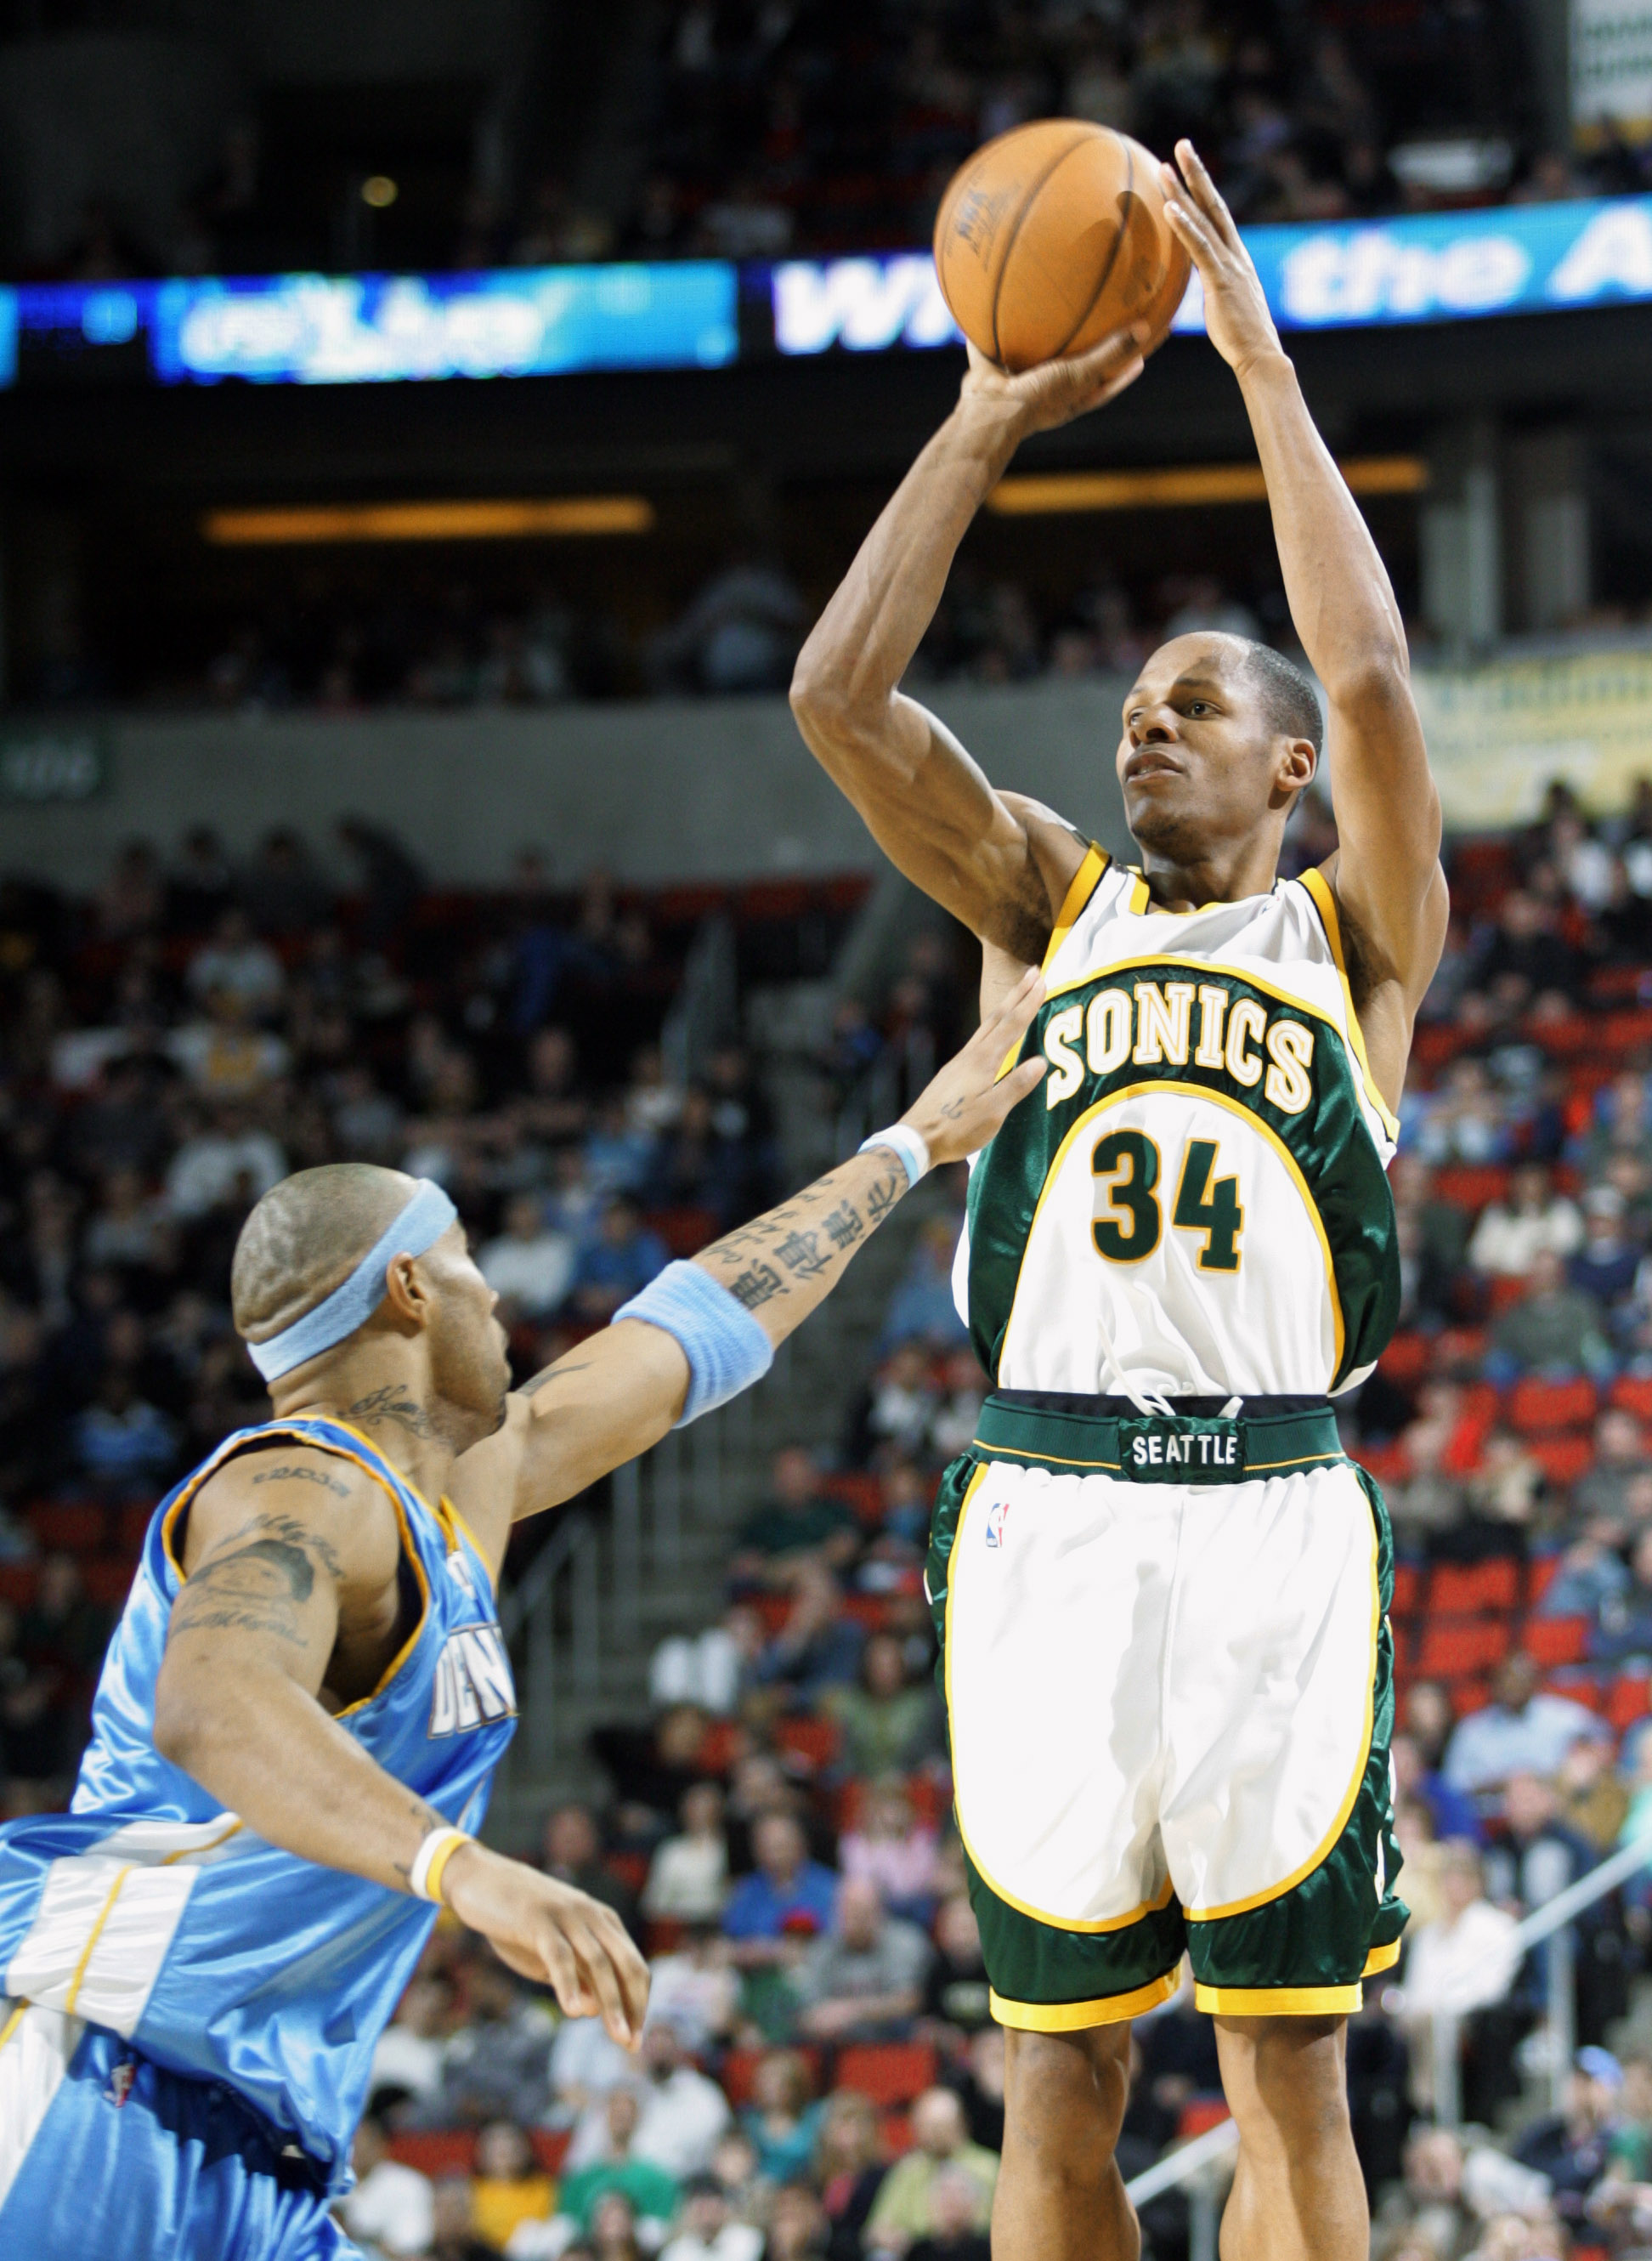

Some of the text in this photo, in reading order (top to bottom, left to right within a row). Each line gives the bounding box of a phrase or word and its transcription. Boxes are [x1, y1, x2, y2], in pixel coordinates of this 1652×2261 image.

[1281, 231, 1530, 321] the
[1044, 982, 1315, 1114] SONICS
[1090, 1126, 1245, 1275] 34
[1132, 1434, 1238, 1465] SEATTLE
